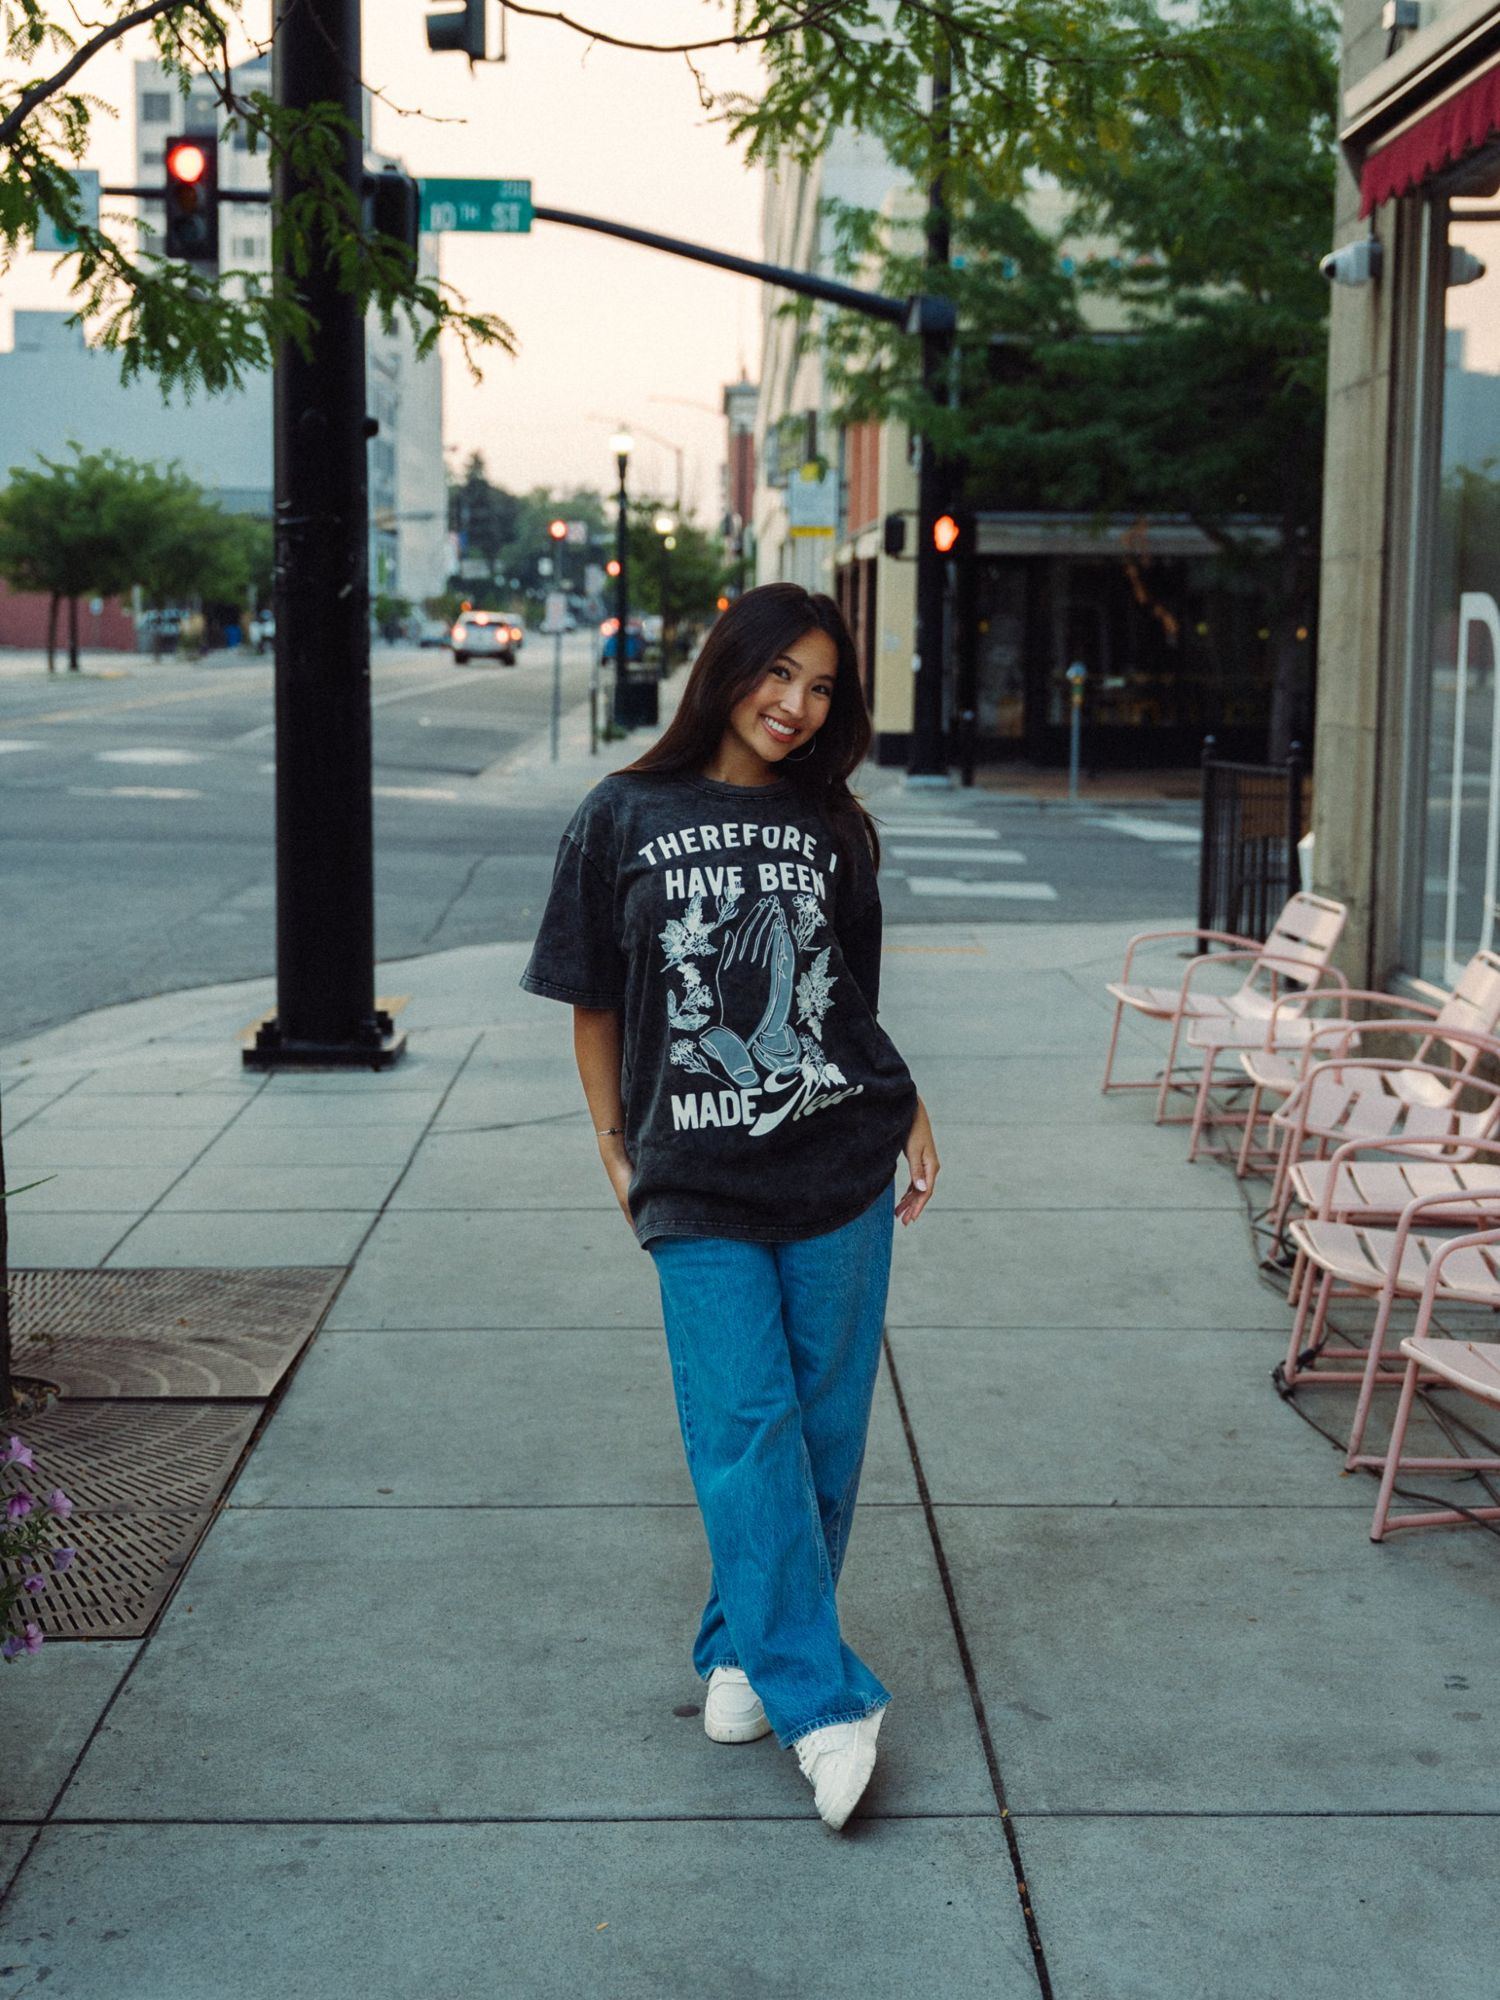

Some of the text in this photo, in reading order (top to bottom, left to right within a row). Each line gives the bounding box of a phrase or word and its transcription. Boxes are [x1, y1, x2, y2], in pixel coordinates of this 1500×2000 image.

[491, 202, 520, 231] ST
[638, 823, 838, 873] THEREFORE I
[664, 862, 827, 901] HAVE BEEN
[670, 1087, 763, 1131] MADE
